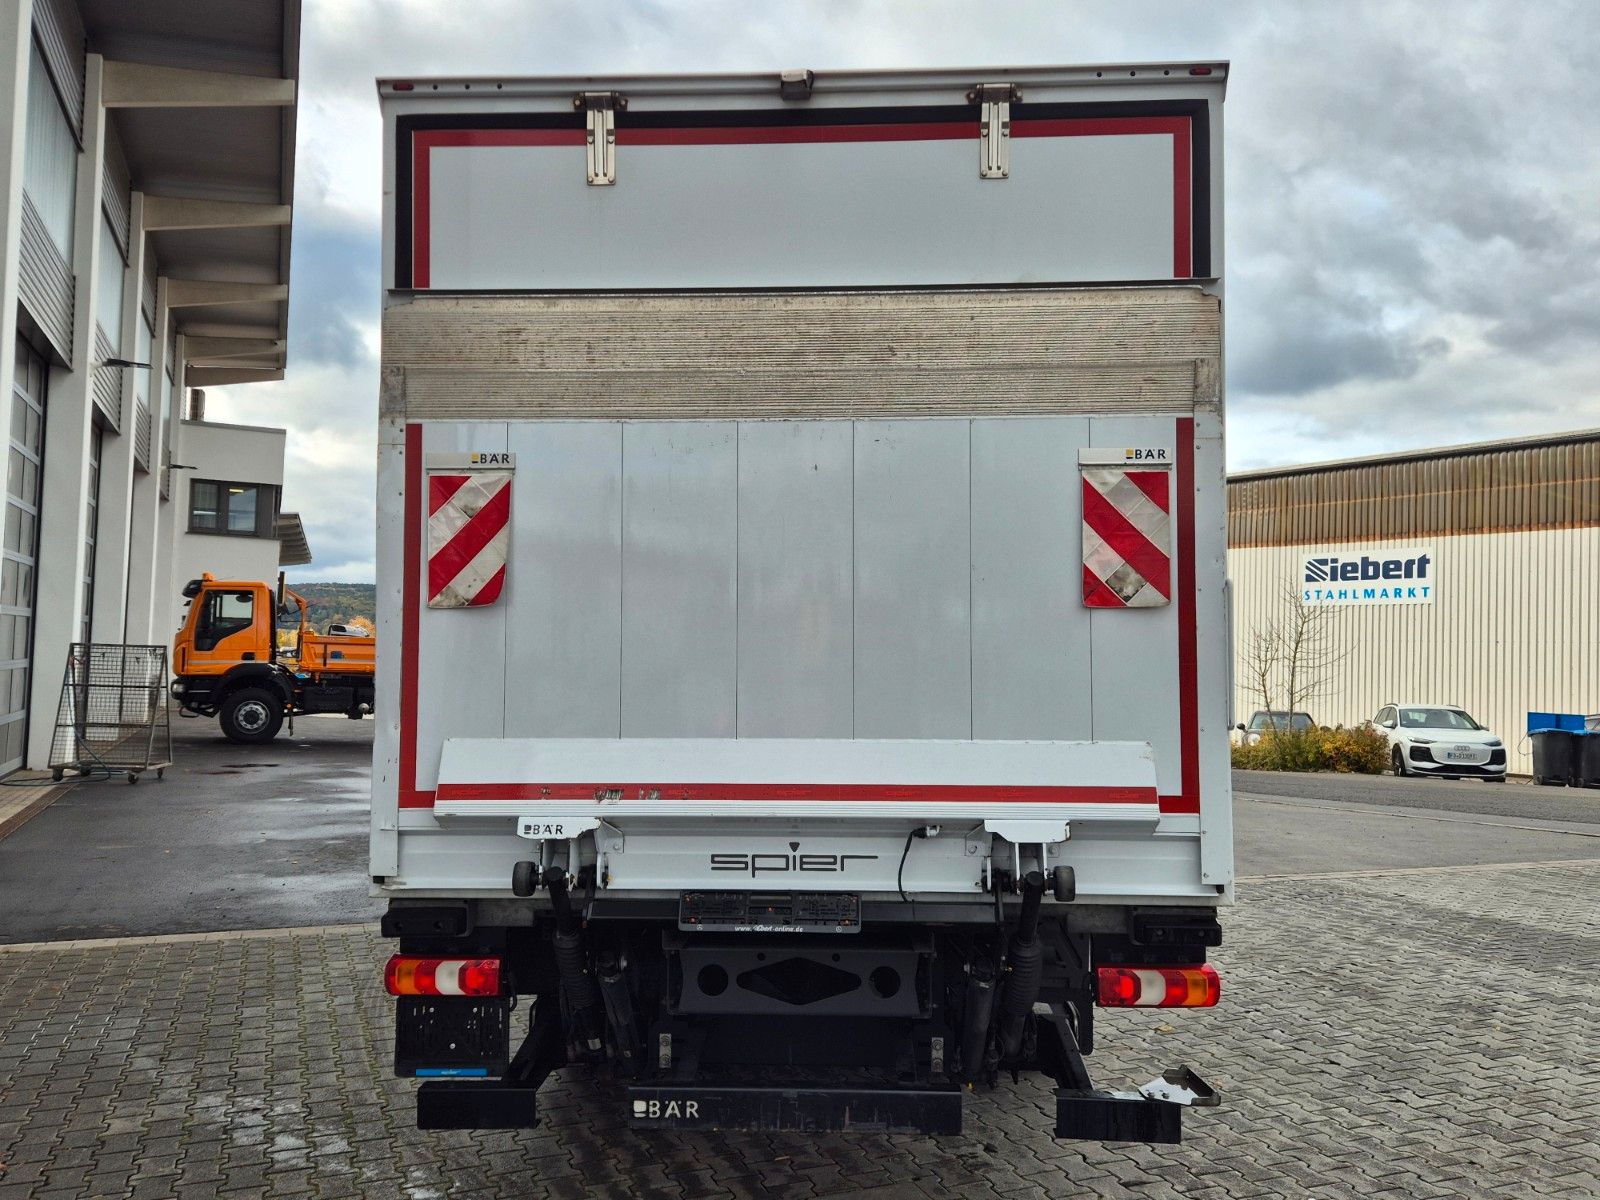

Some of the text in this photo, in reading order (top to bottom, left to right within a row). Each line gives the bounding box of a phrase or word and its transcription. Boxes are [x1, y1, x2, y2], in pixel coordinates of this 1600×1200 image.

[480, 453, 510, 464] BÄR
[1134, 448, 1166, 460] BÄR
[1305, 553, 1431, 583] Siebert
[1304, 586, 1430, 601] STAHLMARKT
[532, 824, 563, 835] BÄR
[710, 841, 879, 878] spier
[648, 1100, 699, 1119] BÄR
